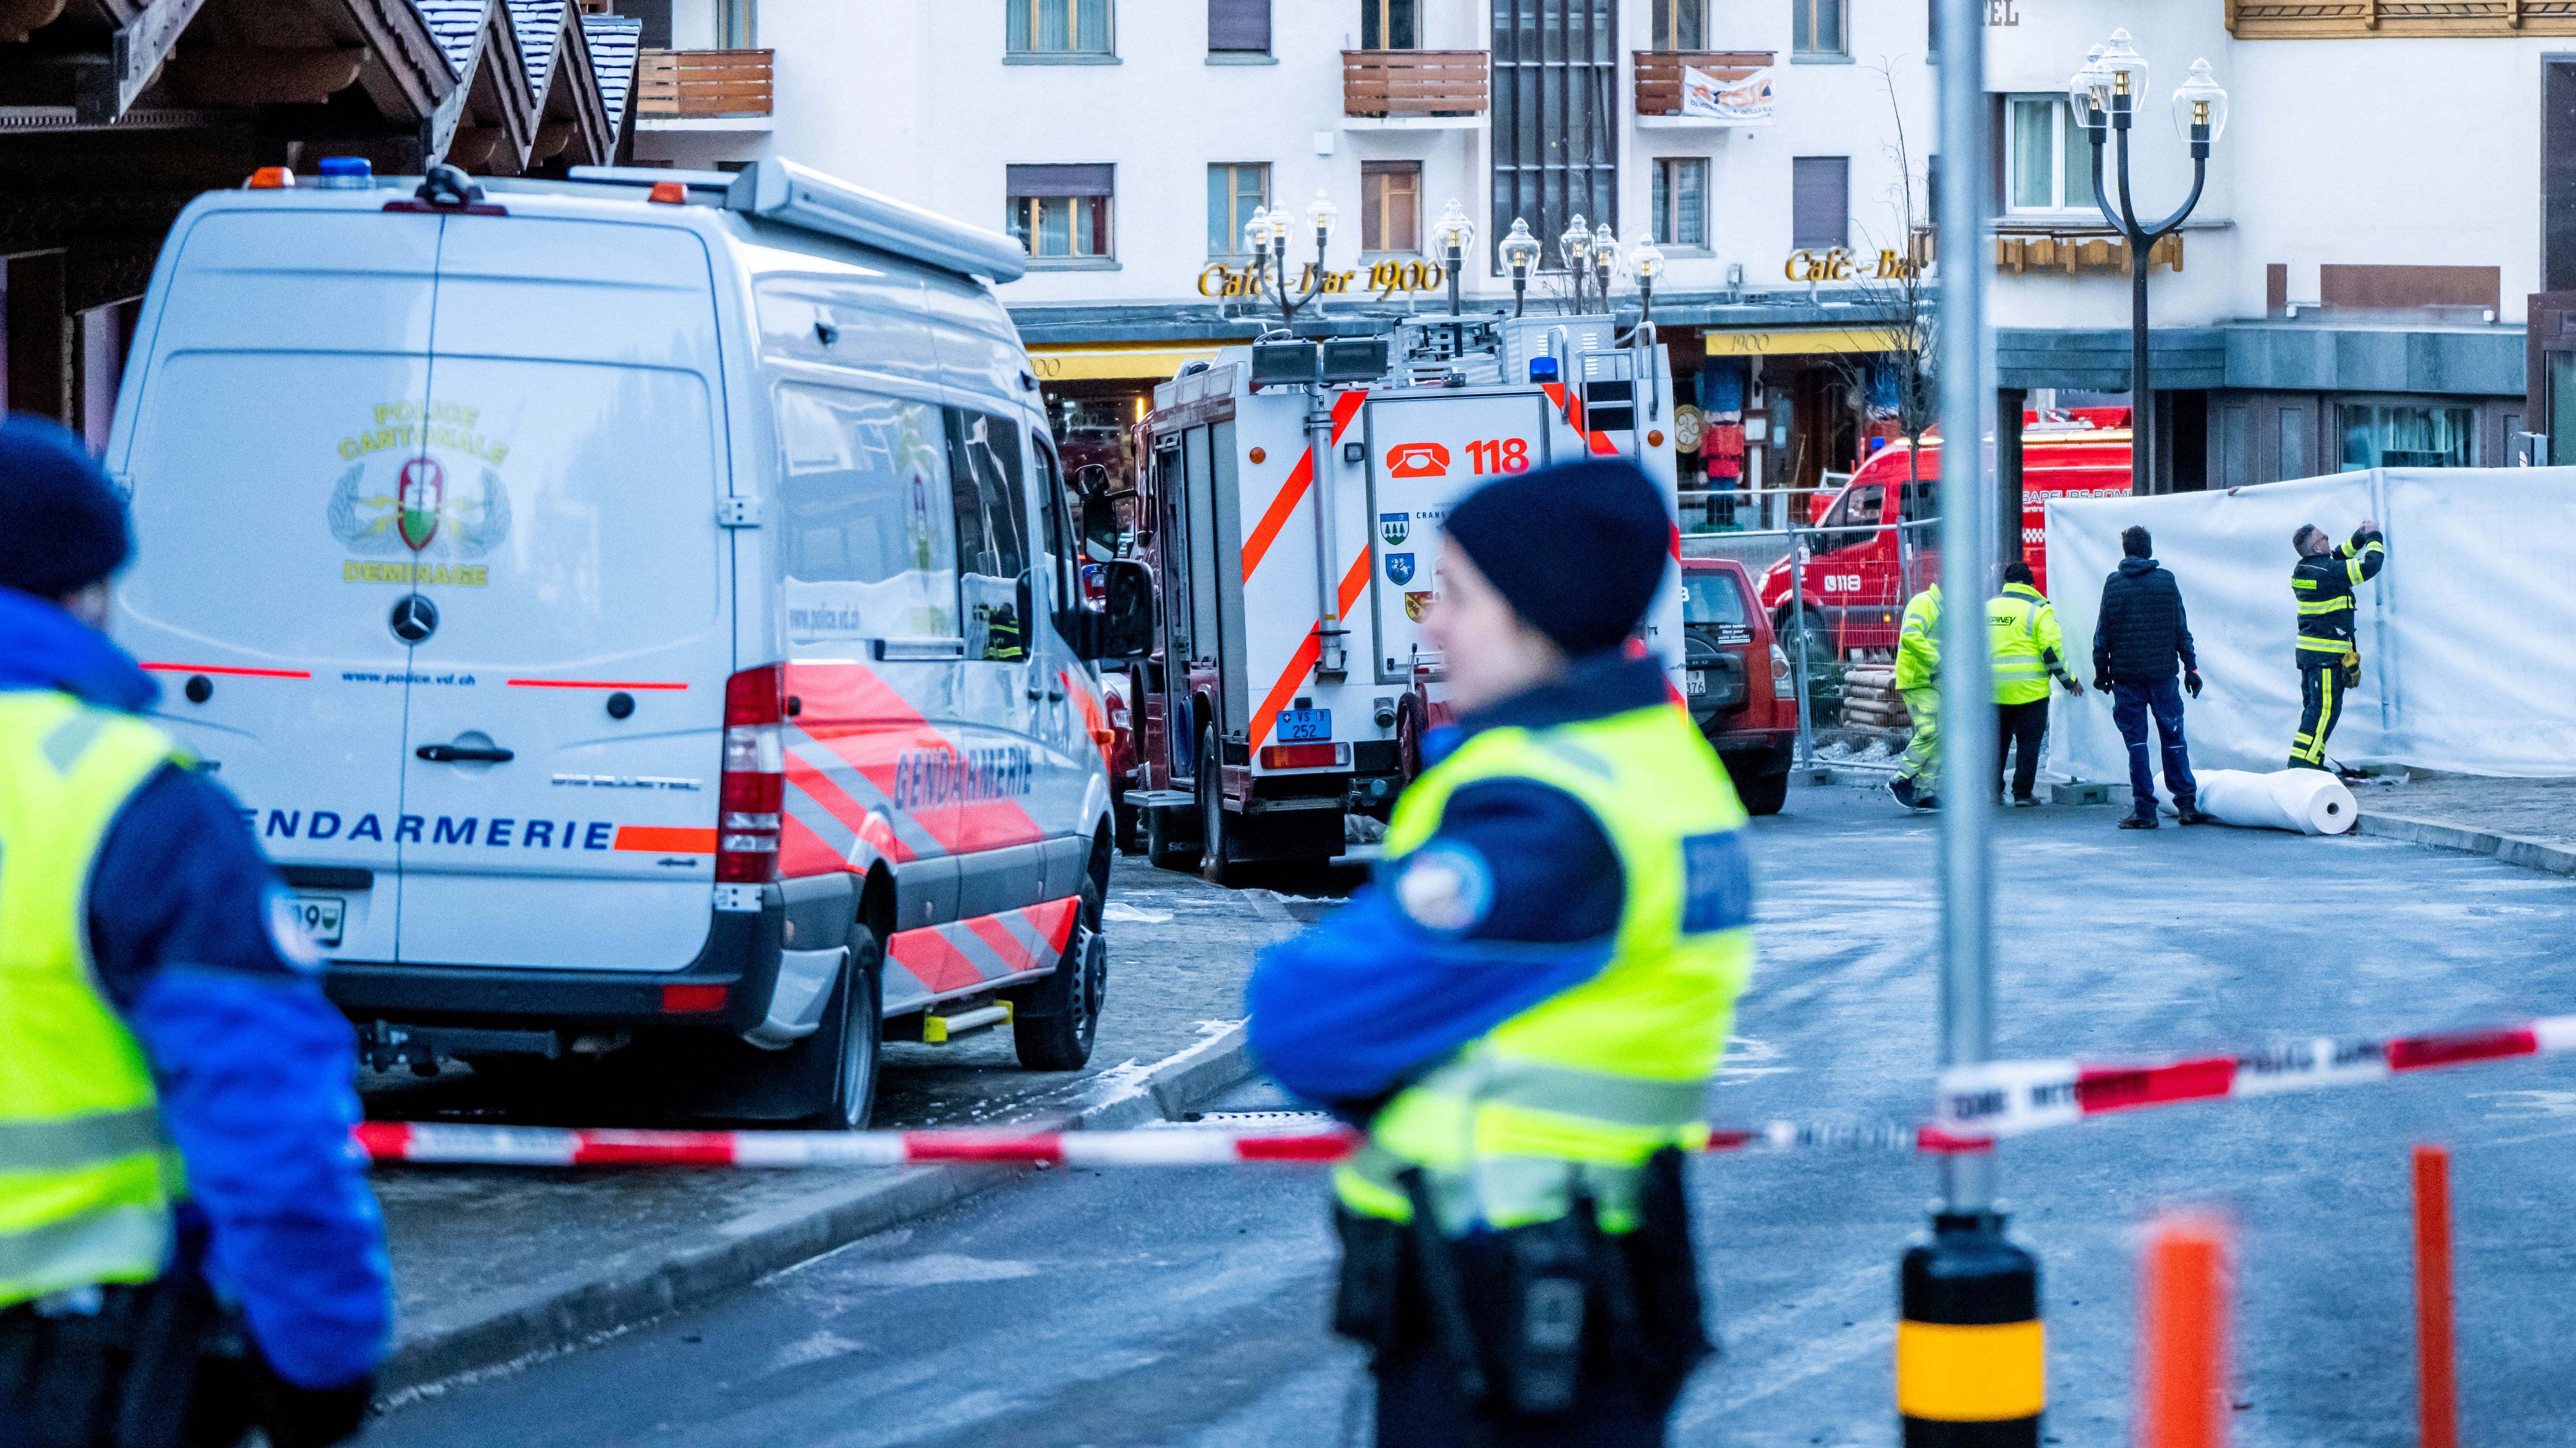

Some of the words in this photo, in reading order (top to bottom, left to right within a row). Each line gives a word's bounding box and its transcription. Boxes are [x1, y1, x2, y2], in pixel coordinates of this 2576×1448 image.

[1984, 0, 2019, 26] EL
[1368, 260, 1444, 302] 1900
[1731, 334, 1770, 352] 1900
[1029, 358, 1060, 377] 00
[374, 401, 479, 430] POLICE
[338, 425, 509, 466] CANTONALE
[1465, 438, 1530, 475] 118
[2022, 488, 2132, 504] SAPEURS-POM
[1836, 575, 1861, 591] 118
[1298, 712, 1310, 722] VS
[1293, 724, 1316, 738] 252
[894, 741, 1032, 810] GENDARMERIE
[240, 808, 613, 850] NDARMERIE
